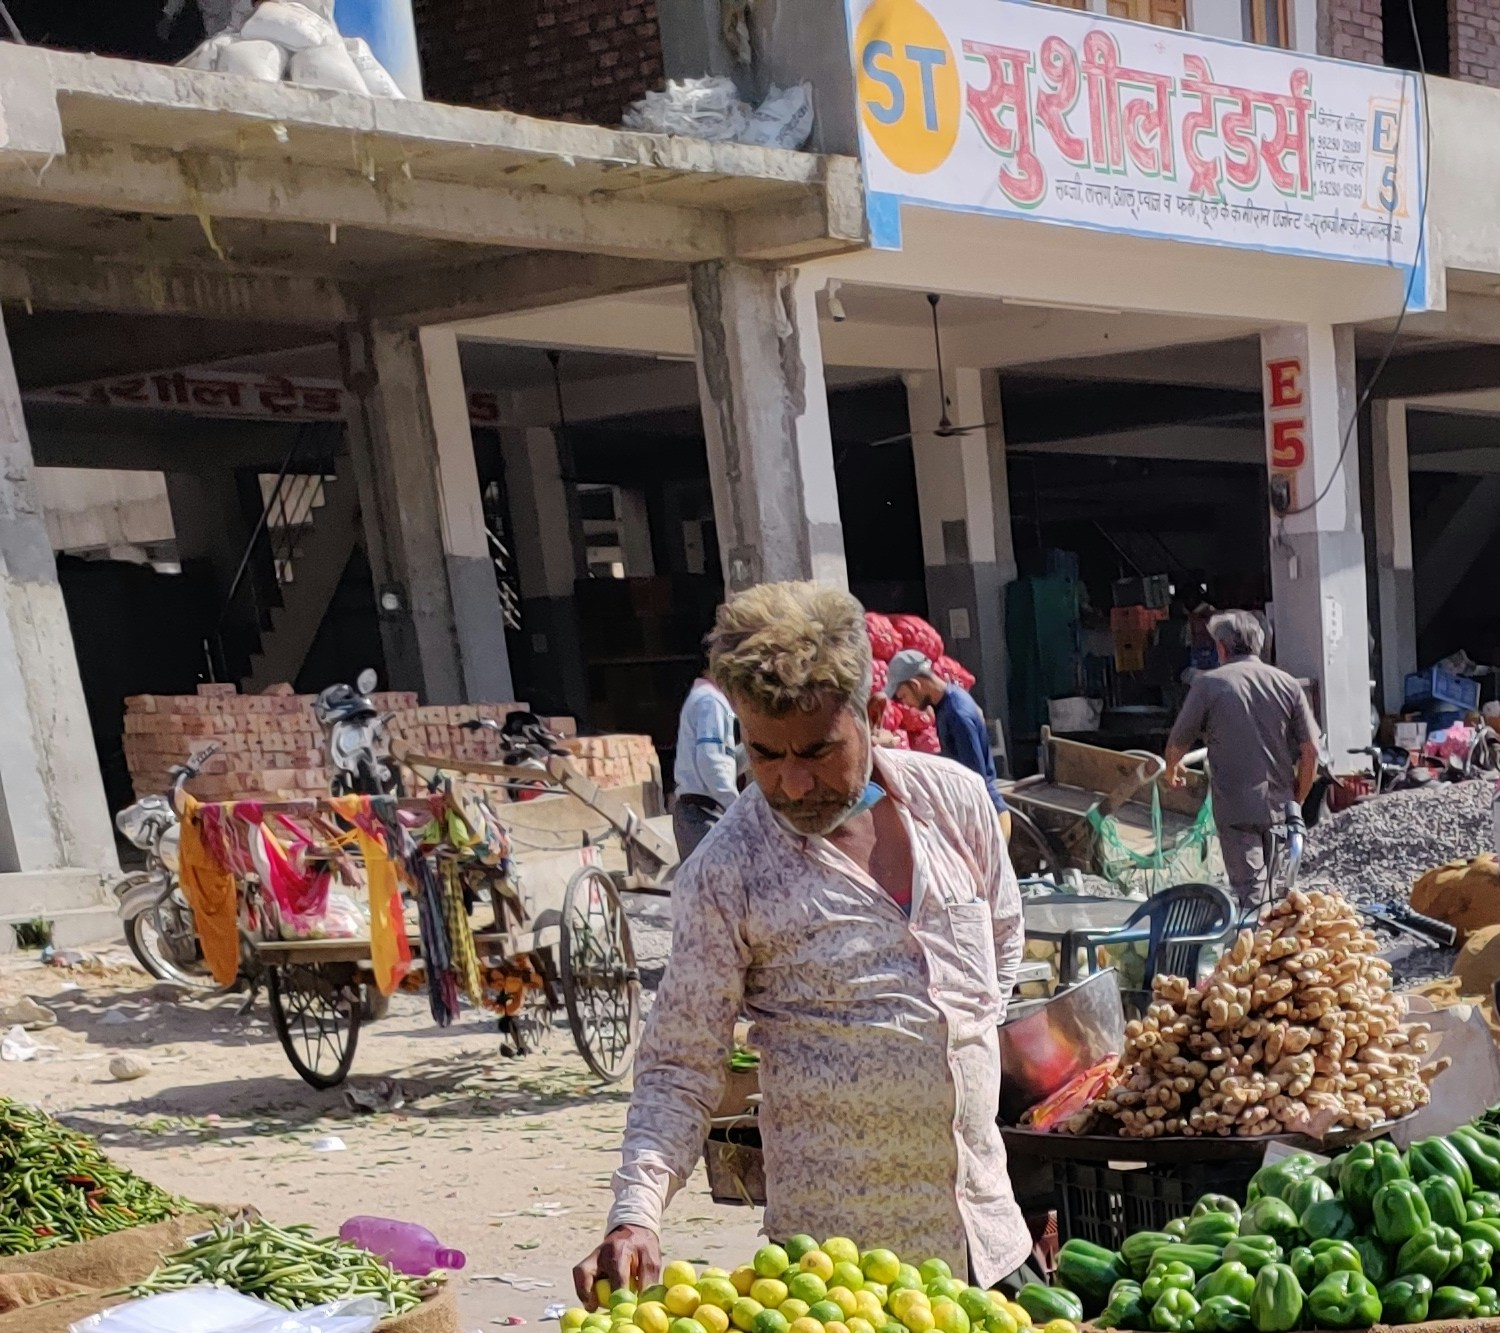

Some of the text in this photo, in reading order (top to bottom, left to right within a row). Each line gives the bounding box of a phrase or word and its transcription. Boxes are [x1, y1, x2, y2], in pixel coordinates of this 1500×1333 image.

[862, 40, 947, 133] ST
[961, 30, 1177, 208] सुशील
[1372, 110, 1397, 154] E
[1379, 166, 1399, 212] 5
[1267, 360, 1303, 408] E
[1272, 419, 1306, 468] 5
